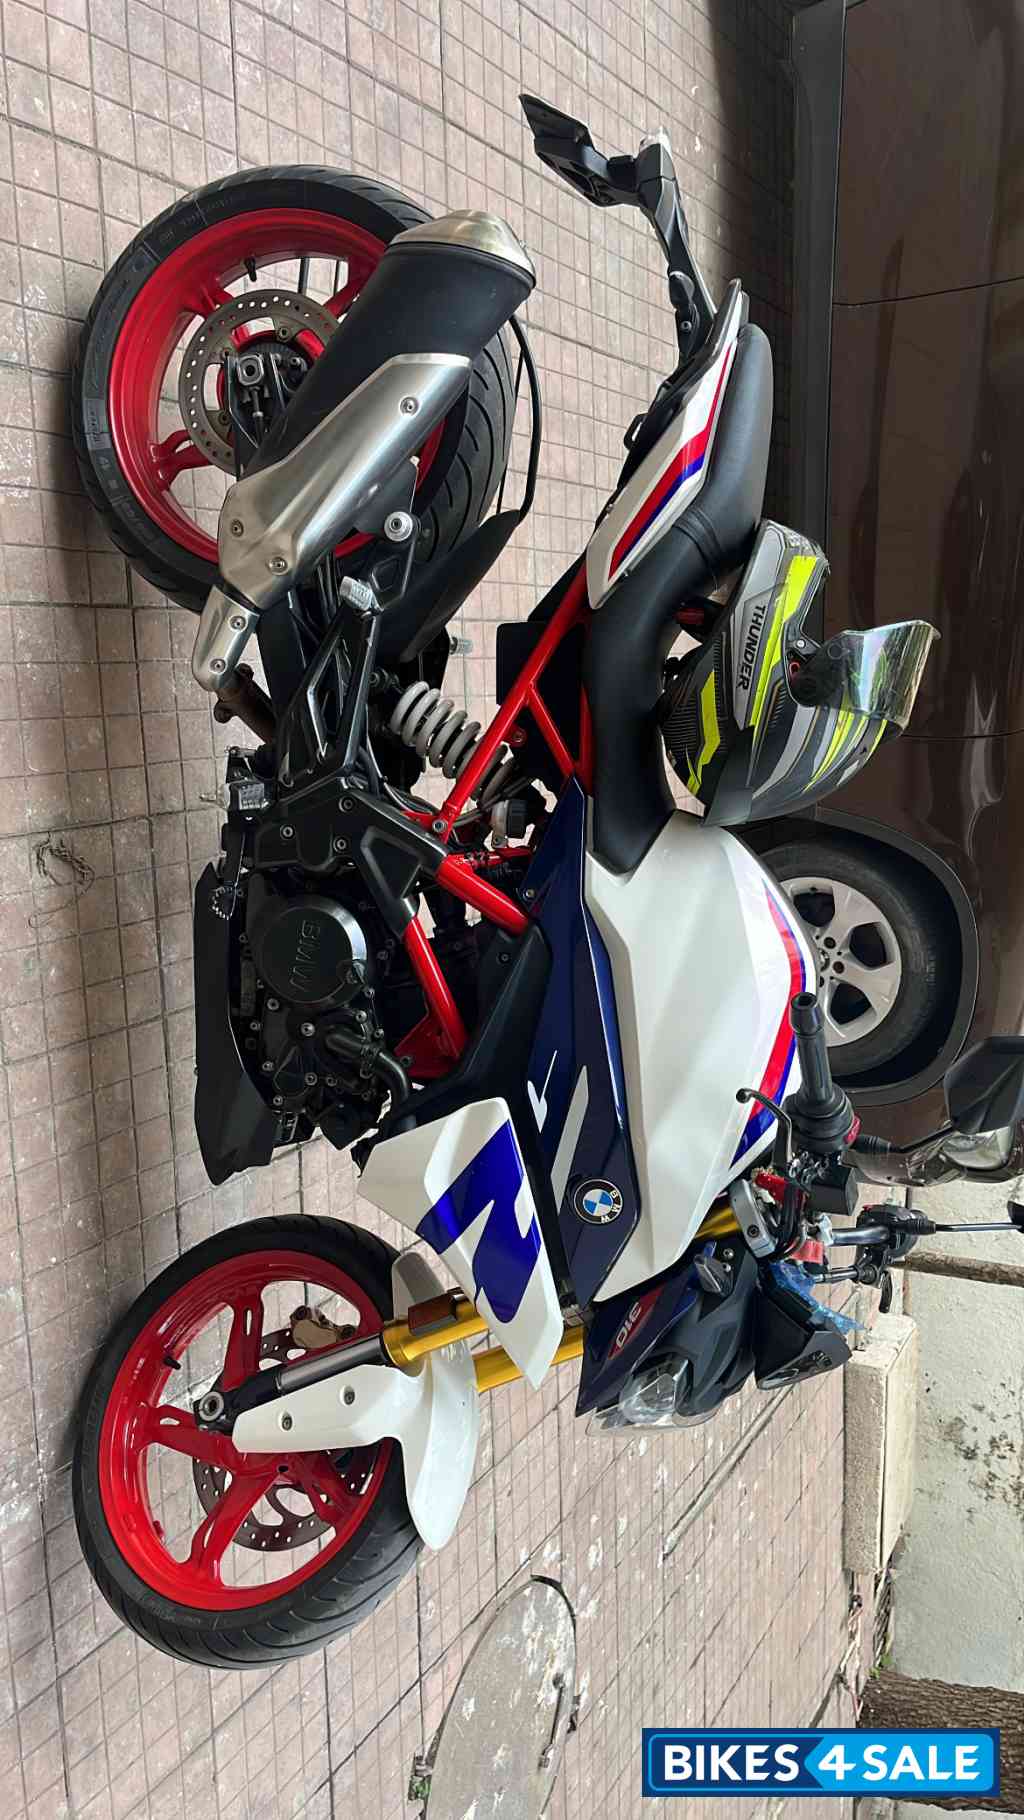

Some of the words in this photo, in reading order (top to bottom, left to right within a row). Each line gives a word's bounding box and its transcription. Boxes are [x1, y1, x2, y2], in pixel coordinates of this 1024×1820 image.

[737, 605, 767, 691] THUNDER
[289, 919, 321, 992] BMW
[600, 1189, 623, 1224] BMW
